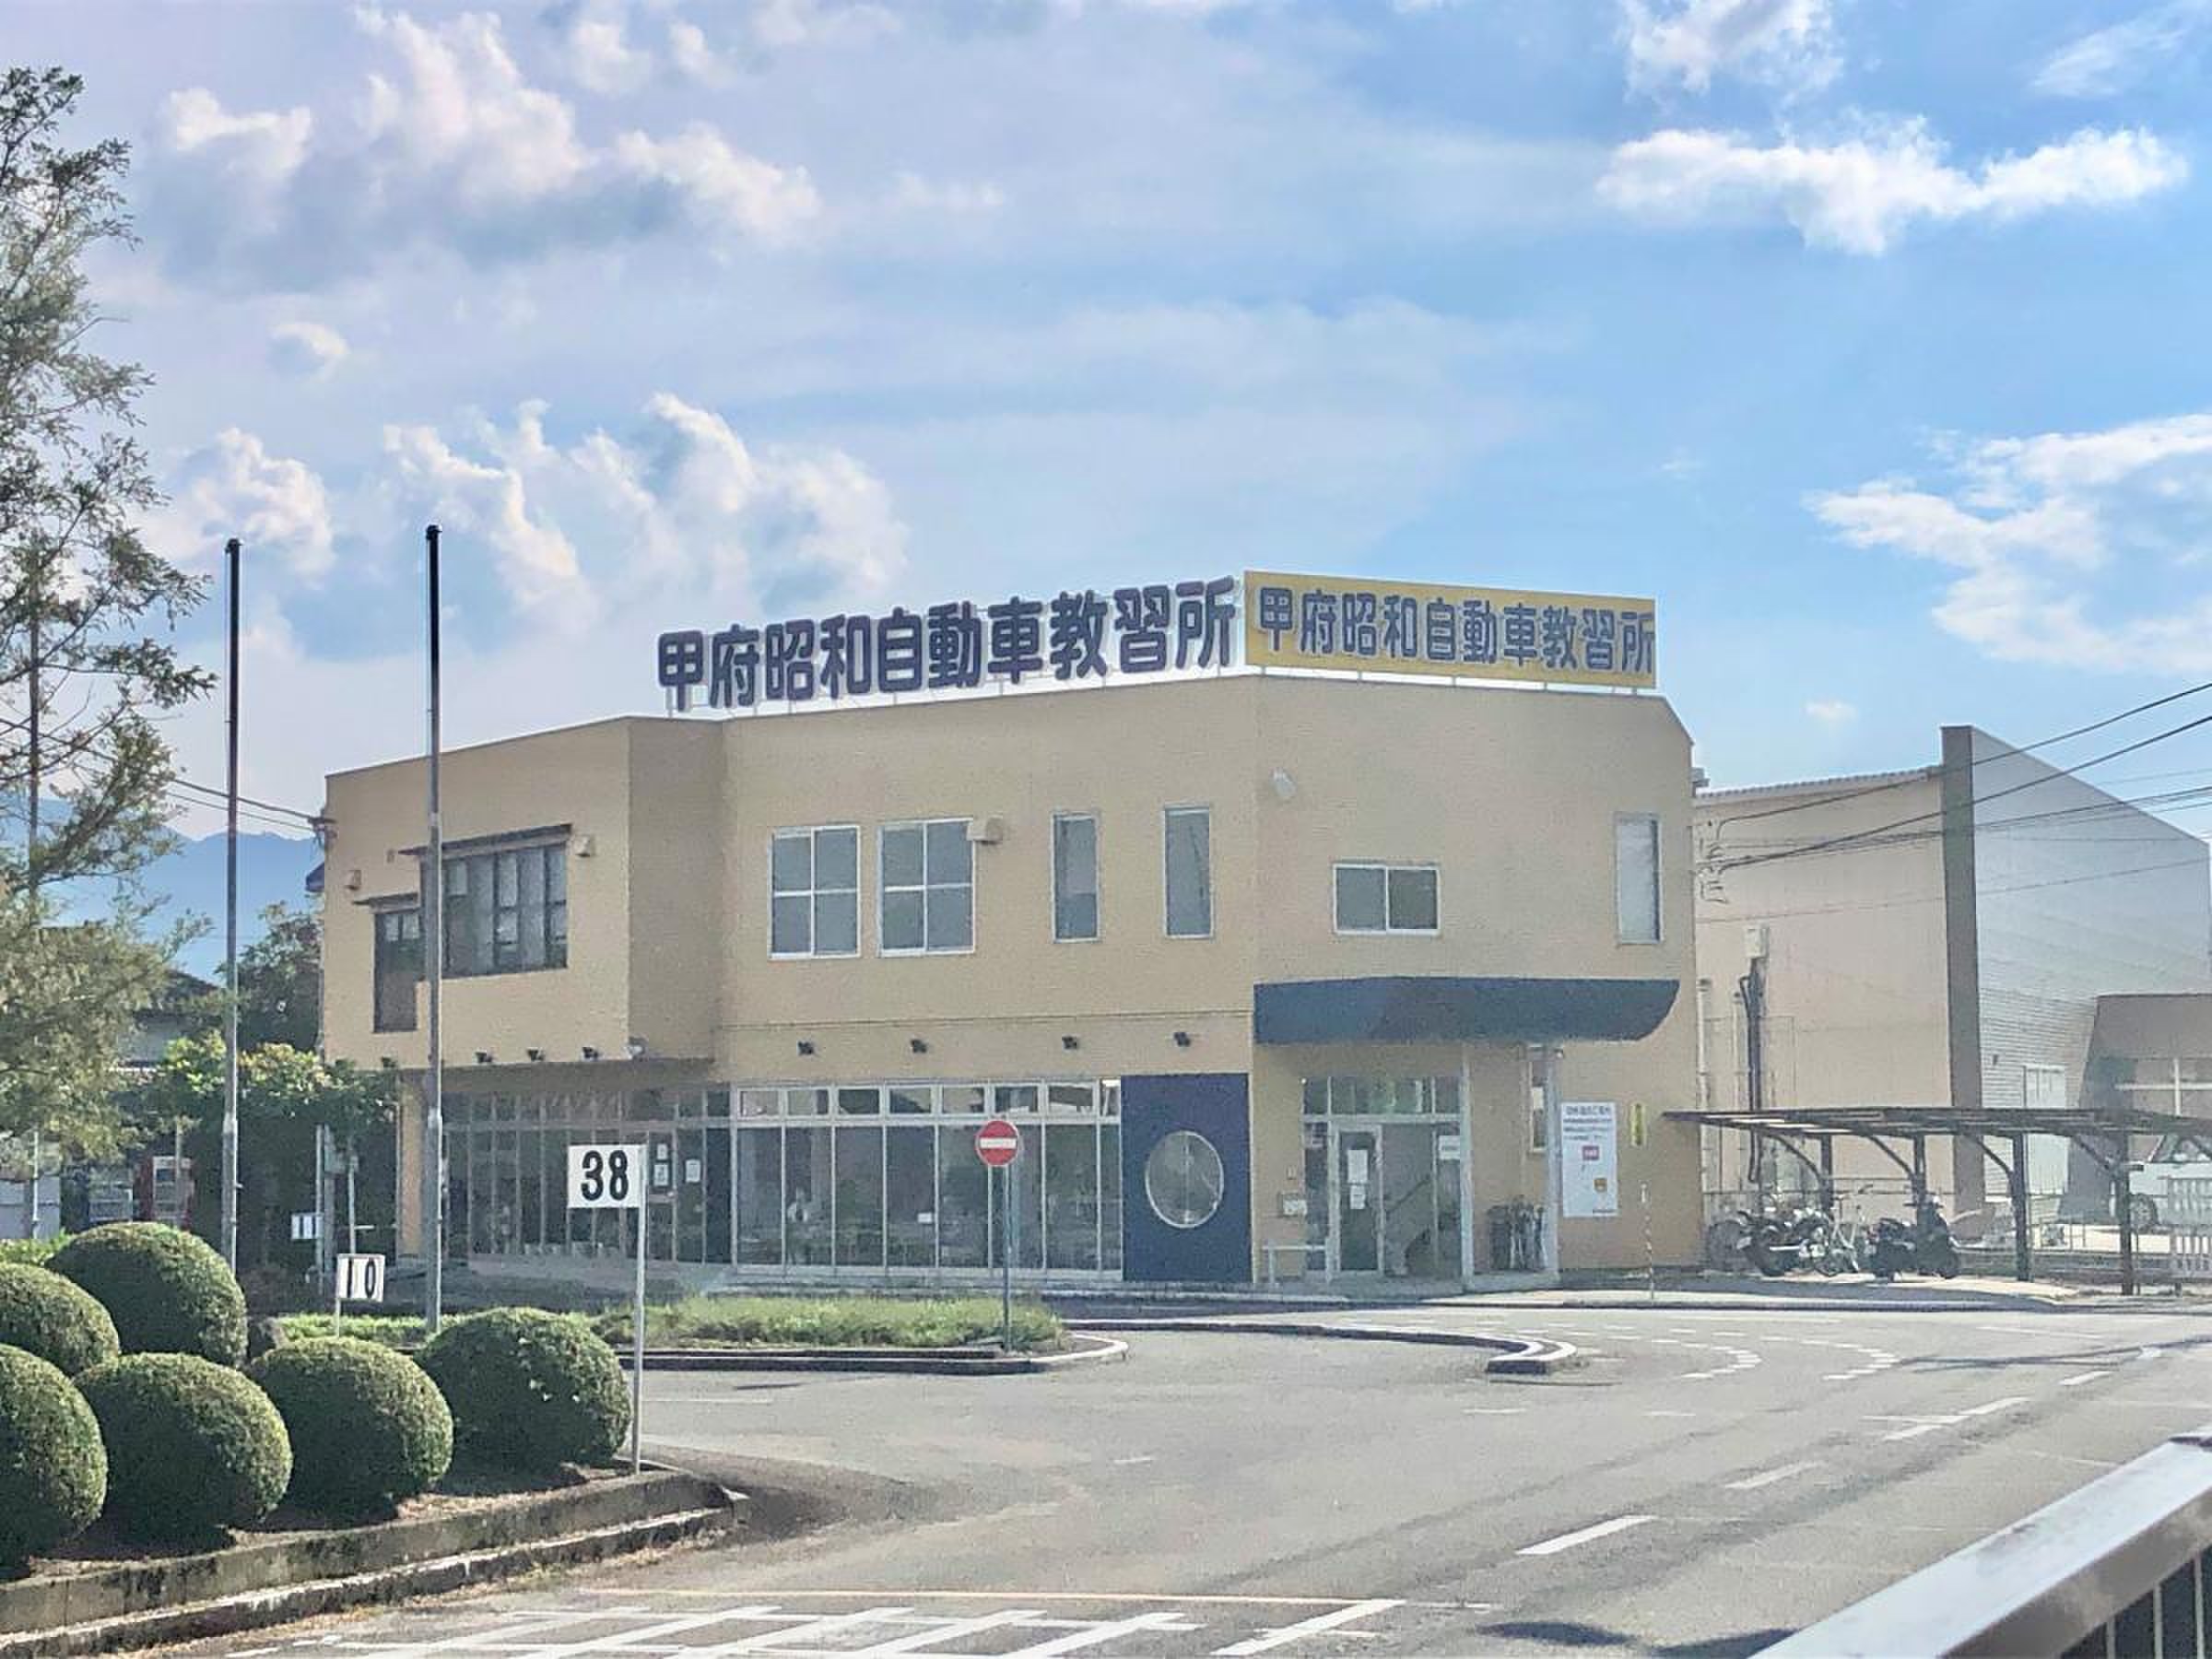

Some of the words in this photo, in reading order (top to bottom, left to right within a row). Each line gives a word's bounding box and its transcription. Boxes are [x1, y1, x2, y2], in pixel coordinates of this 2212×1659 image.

[657, 575, 1236, 712] 甲府昭和自動車教習所
[1259, 585, 1655, 676] 甲府昭和自動車教習所
[581, 1149, 629, 1202] 38
[347, 1256, 376, 1300] 10
